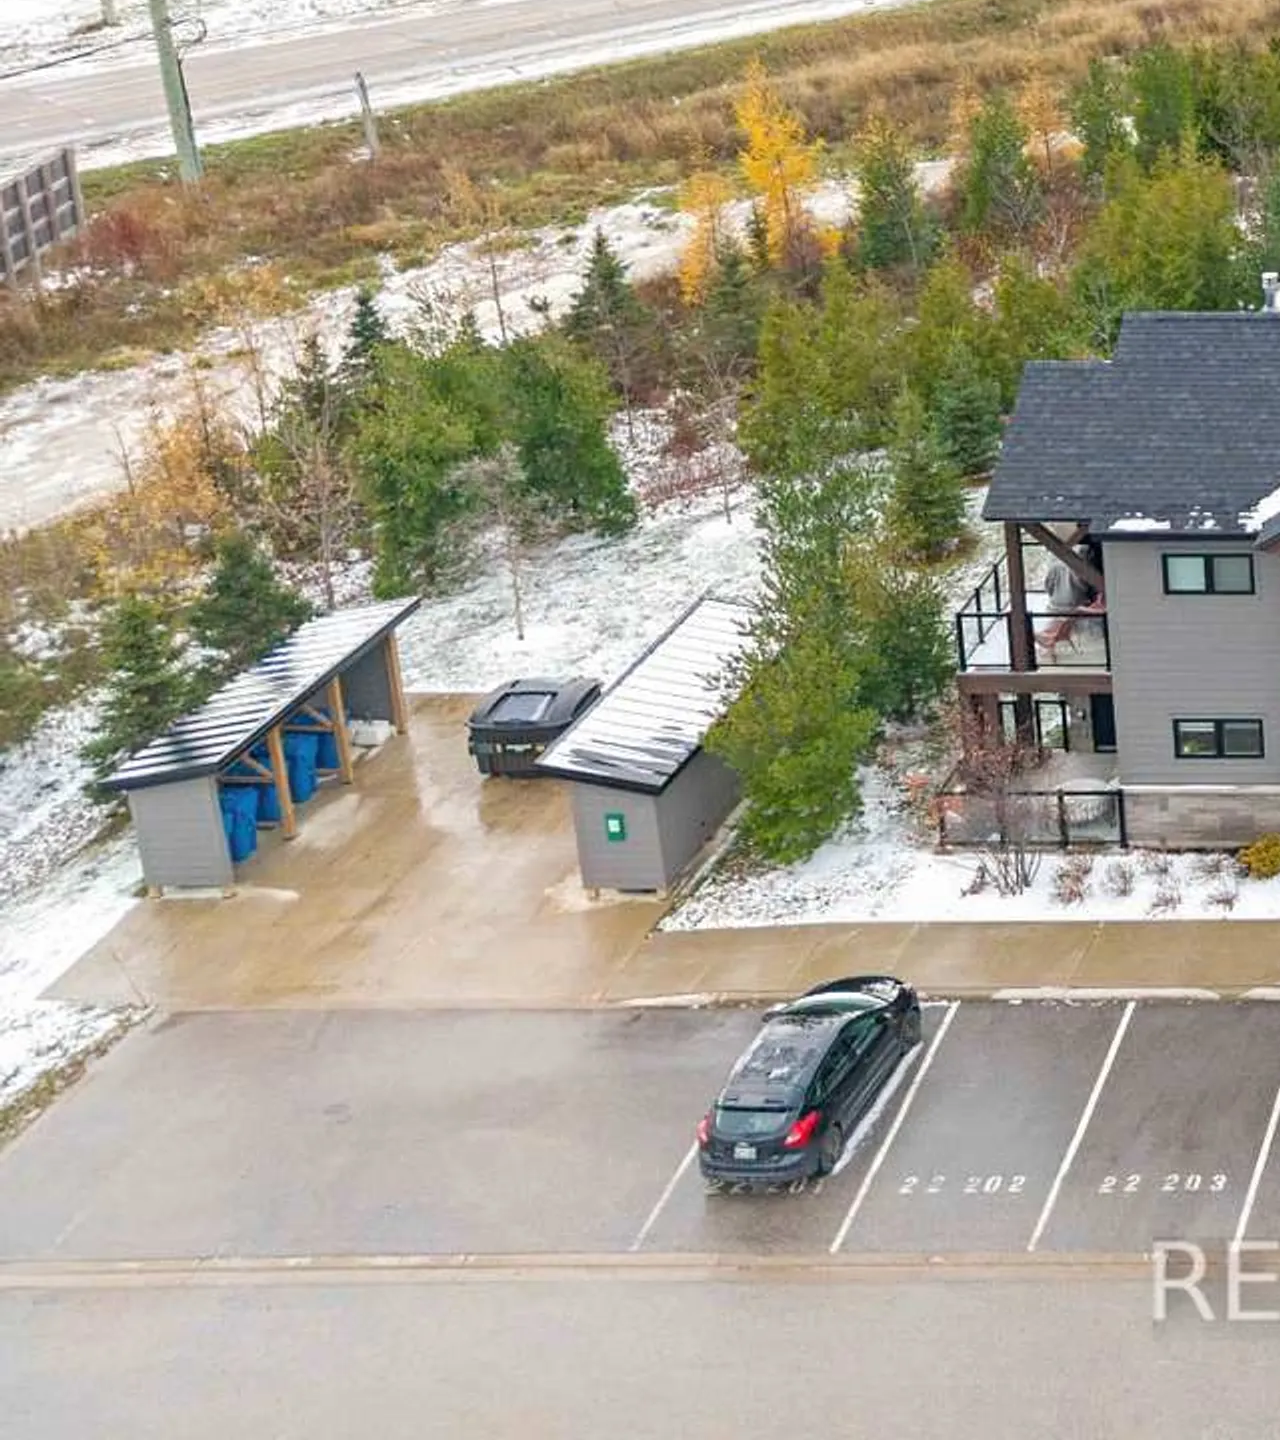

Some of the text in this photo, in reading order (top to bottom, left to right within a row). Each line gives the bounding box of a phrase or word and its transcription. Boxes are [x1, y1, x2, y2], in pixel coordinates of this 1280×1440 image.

[898, 1175, 1026, 1194] 22 202
[1098, 1173, 1227, 1194] 22 203
